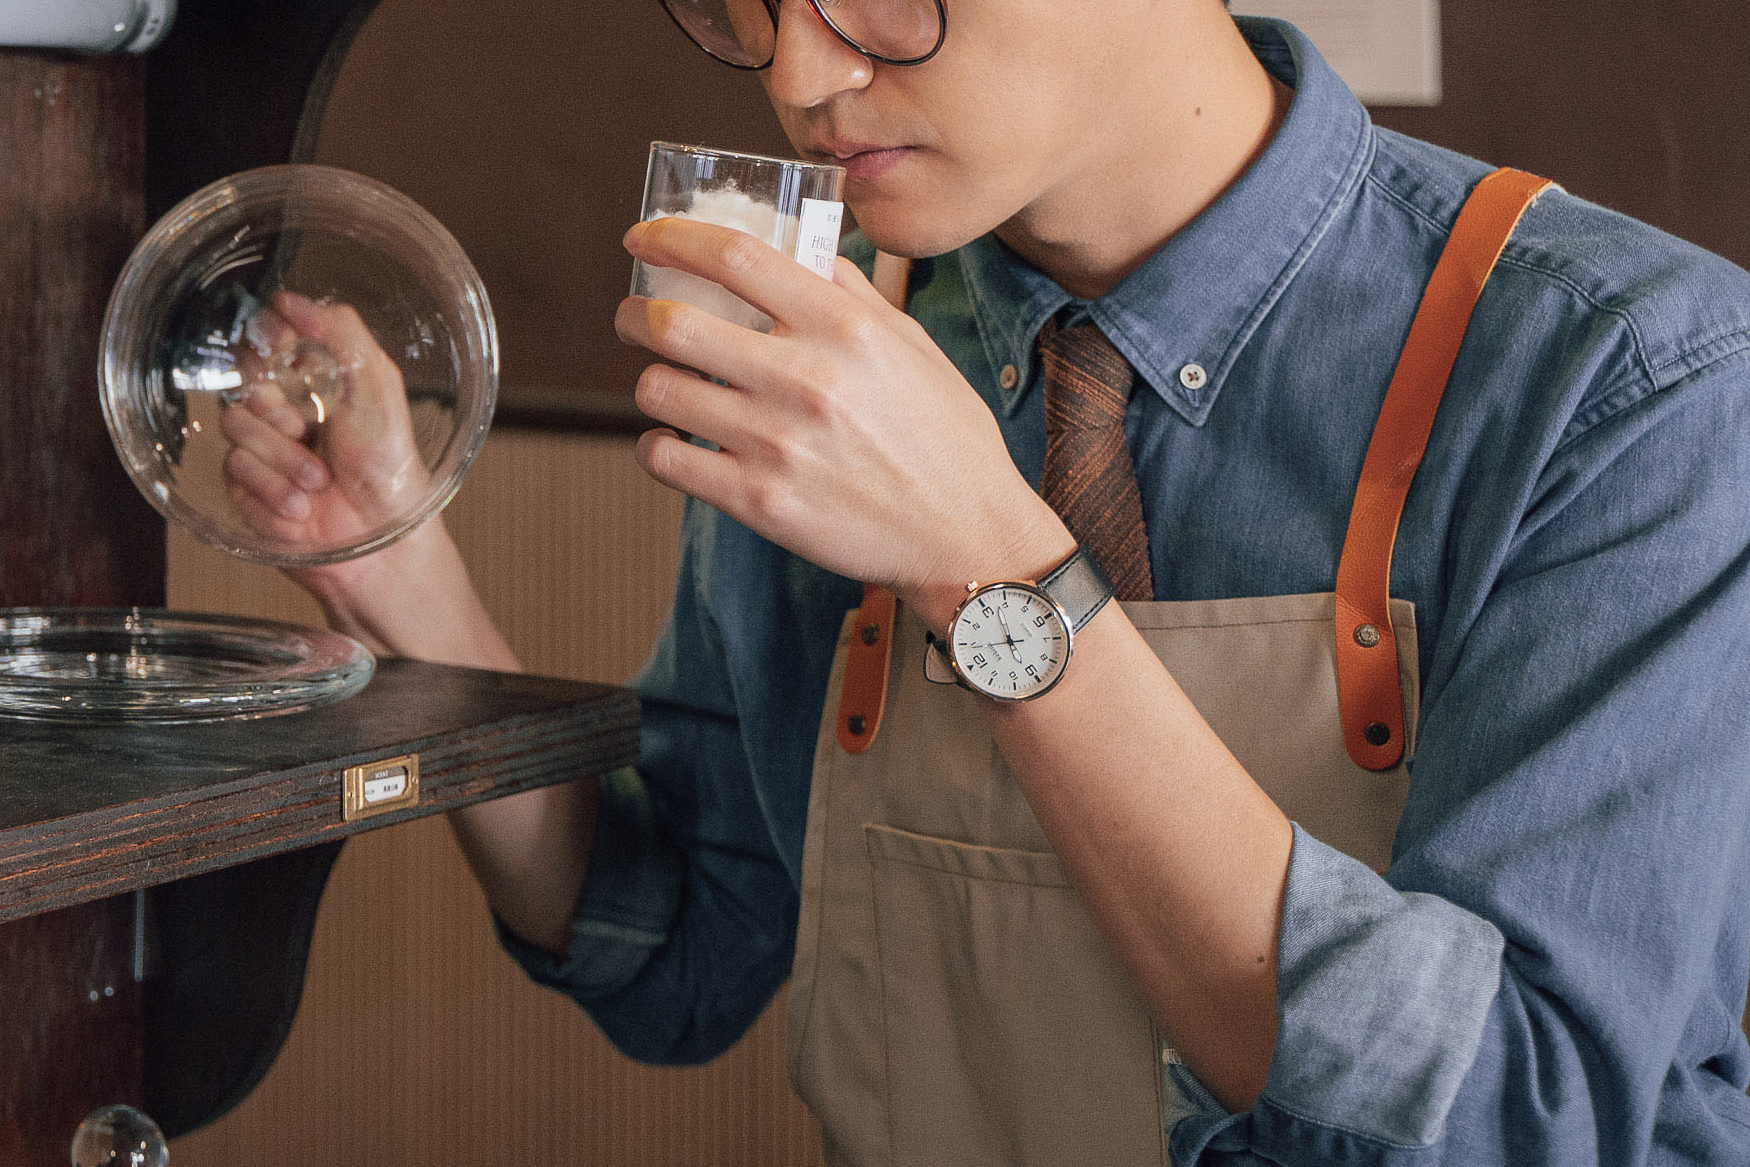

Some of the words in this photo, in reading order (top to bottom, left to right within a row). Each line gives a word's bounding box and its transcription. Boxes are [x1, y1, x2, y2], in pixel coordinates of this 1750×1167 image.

[982, 606, 995, 619] 3
[1020, 605, 1029, 613] 5
[972, 622, 981, 630] 2
[1032, 616, 1046, 628] 6
[973, 653, 988, 669] 12
[1040, 653, 1048, 661] 8
[1025, 664, 1038, 676] 9
[1009, 671, 1019, 681] 10
